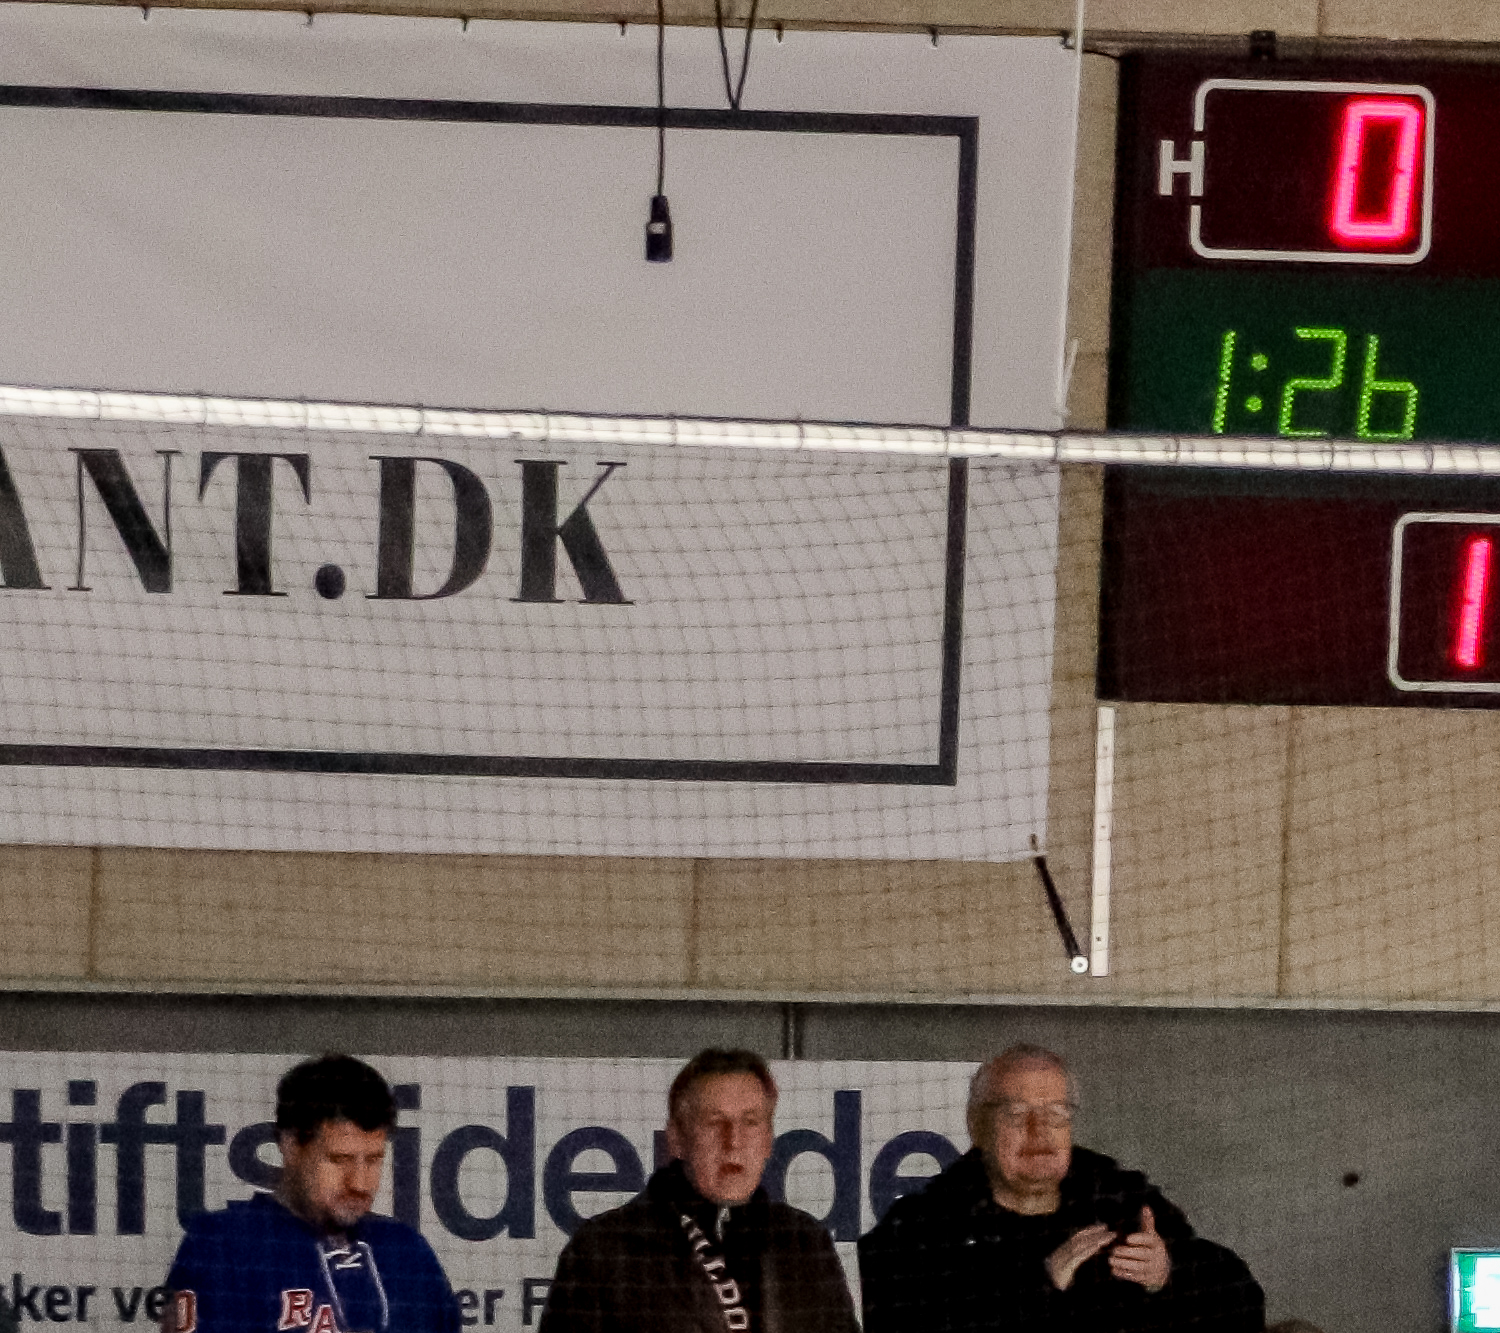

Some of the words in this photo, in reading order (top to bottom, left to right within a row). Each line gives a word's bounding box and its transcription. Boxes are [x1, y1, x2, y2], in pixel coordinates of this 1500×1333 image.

[1159, 140, 1204, 197] H
[1330, 98, 1424, 244] 0
[1213, 328, 1419, 441] 1:26
[0, 1278, 96, 1323] ker
